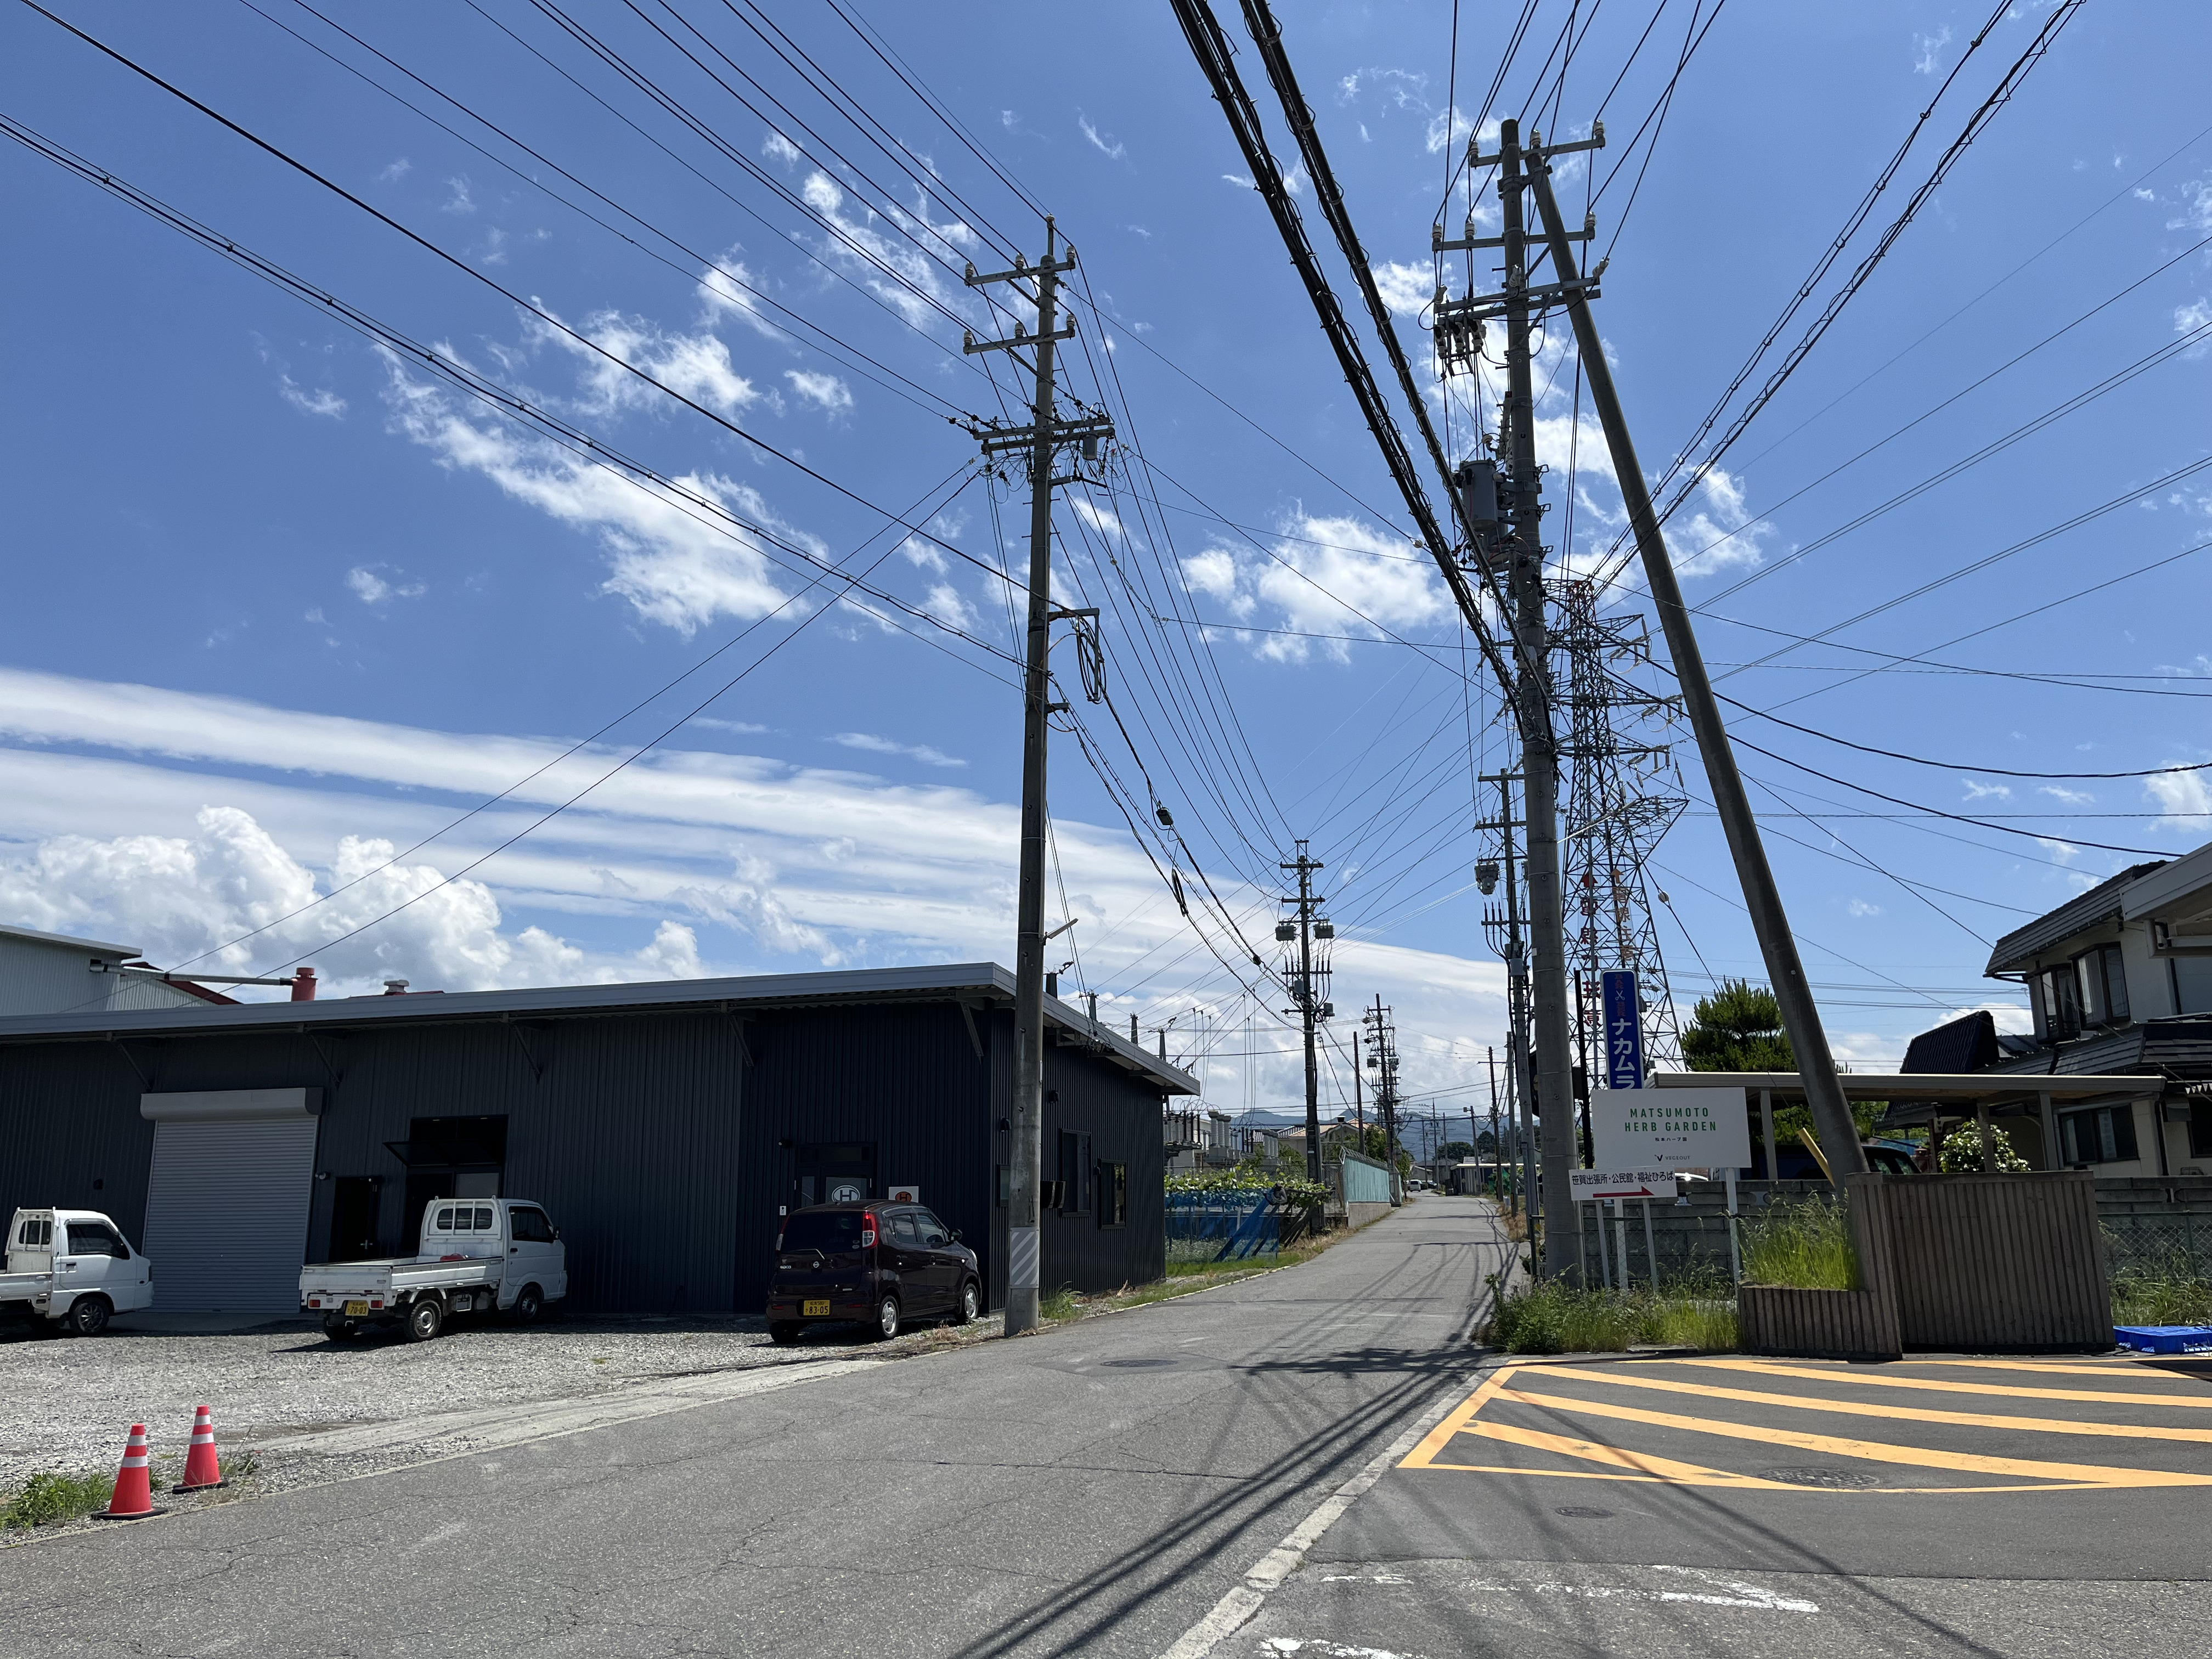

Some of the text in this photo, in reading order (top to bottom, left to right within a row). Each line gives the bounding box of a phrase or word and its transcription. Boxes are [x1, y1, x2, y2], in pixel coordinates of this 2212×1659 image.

[1612, 1018, 1635, 1089] ナカムラ
[1630, 1107, 1709, 1118] MATSUMOTO
[1624, 1121, 1716, 1132] HERB GARDEN
